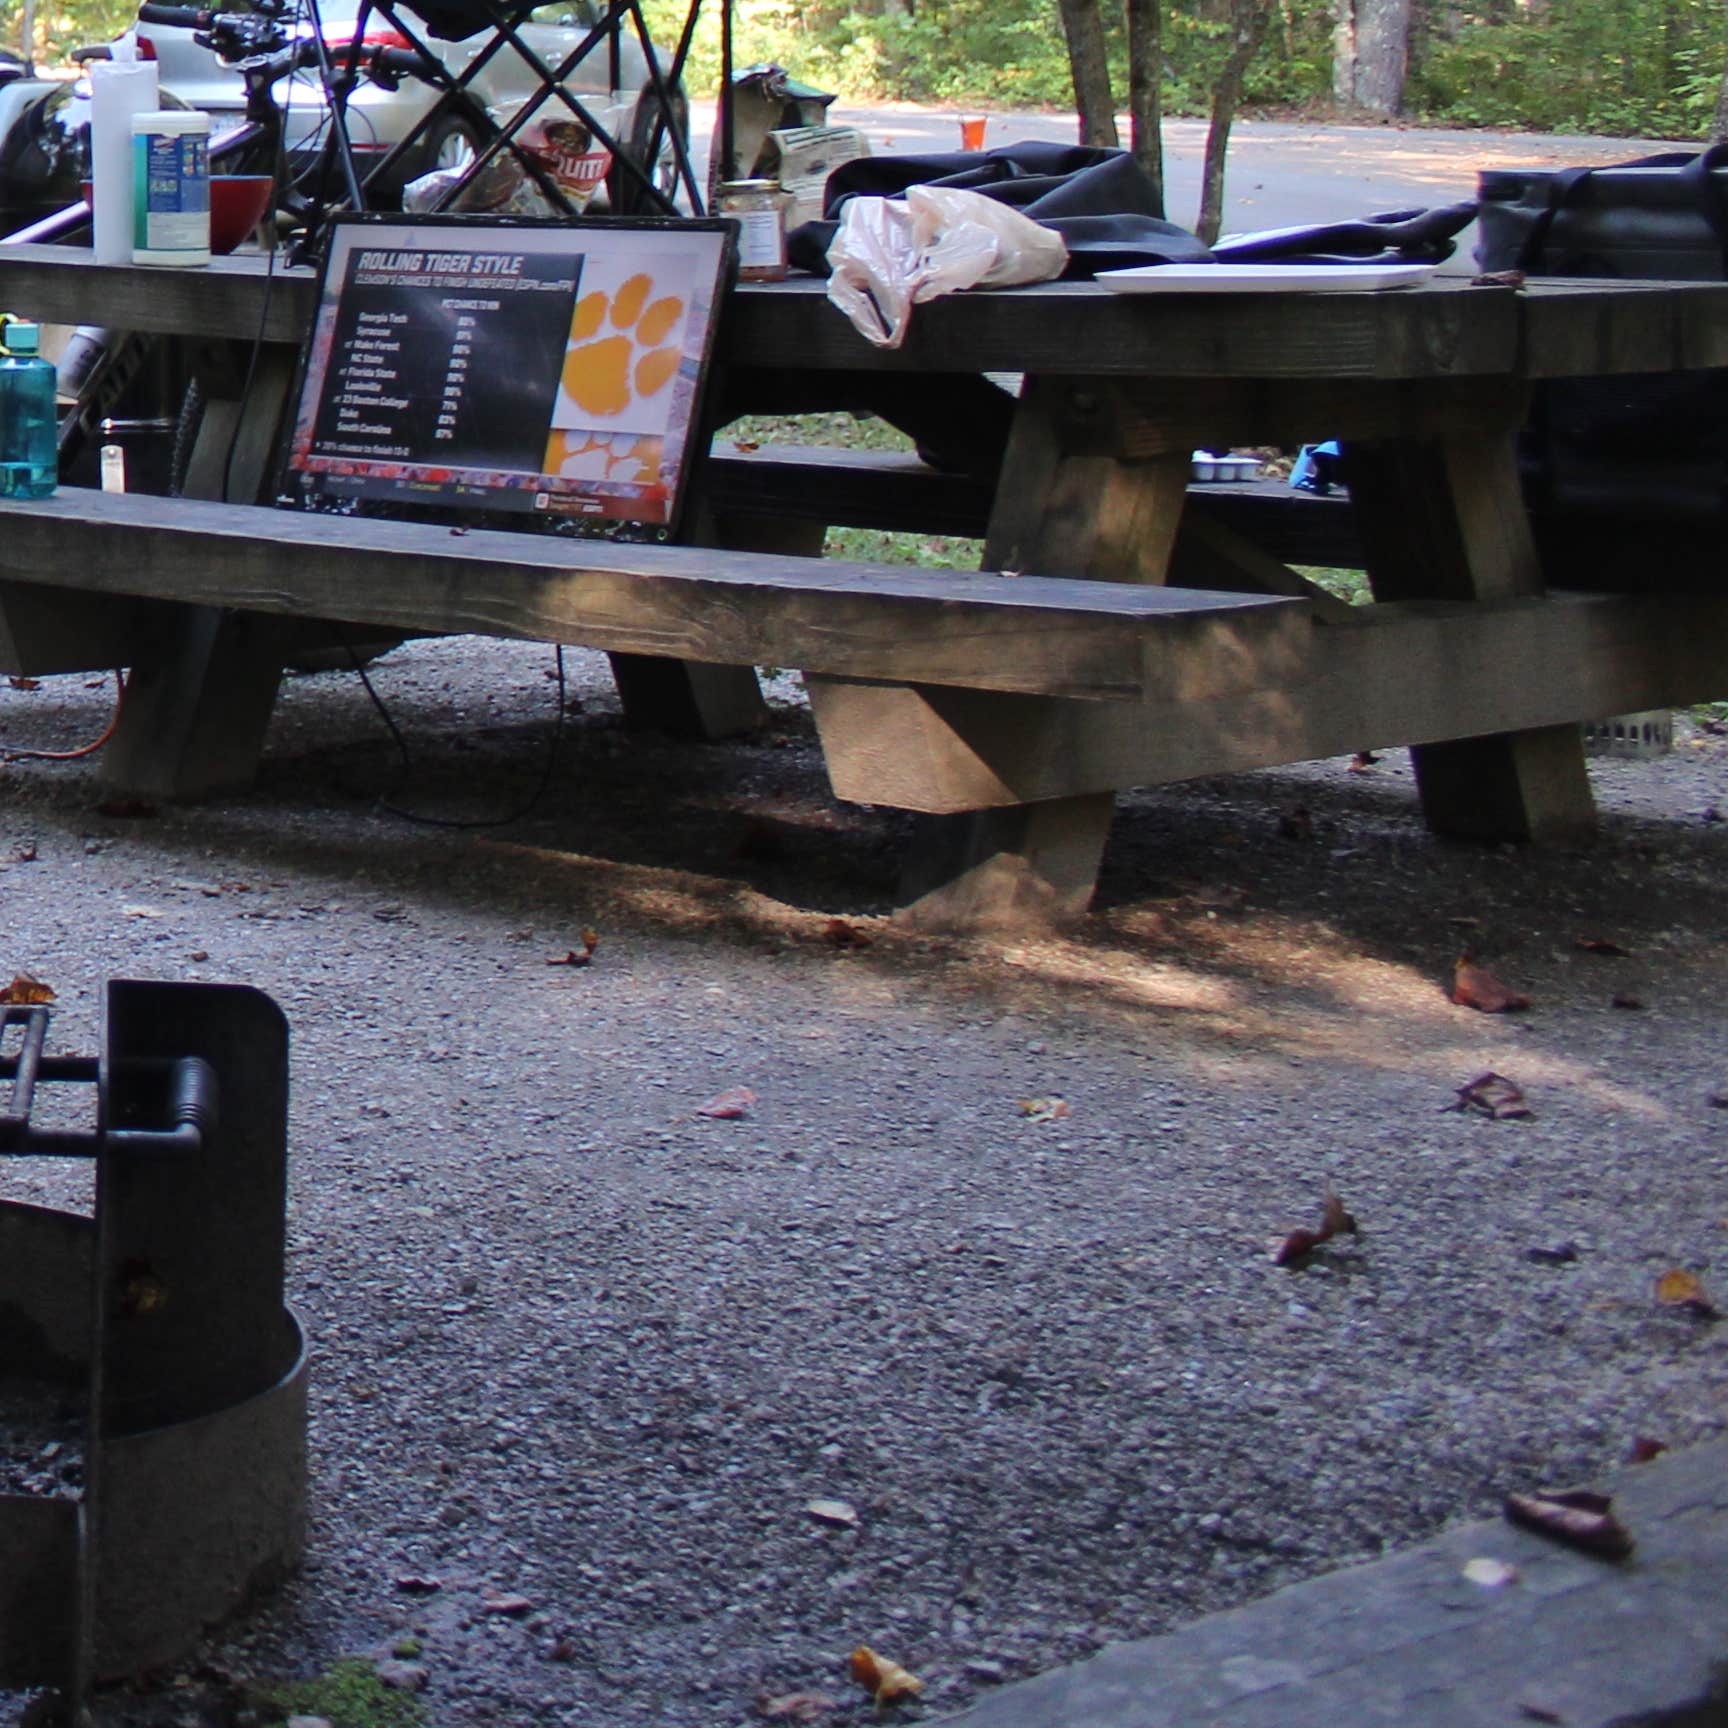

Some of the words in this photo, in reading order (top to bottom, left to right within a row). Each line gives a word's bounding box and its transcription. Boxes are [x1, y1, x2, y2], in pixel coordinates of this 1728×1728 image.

[357, 251, 424, 272] ROLLING
[425, 253, 472, 273] TIGER
[472, 255, 525, 275] STYLE
[374, 340, 401, 352] Forest
